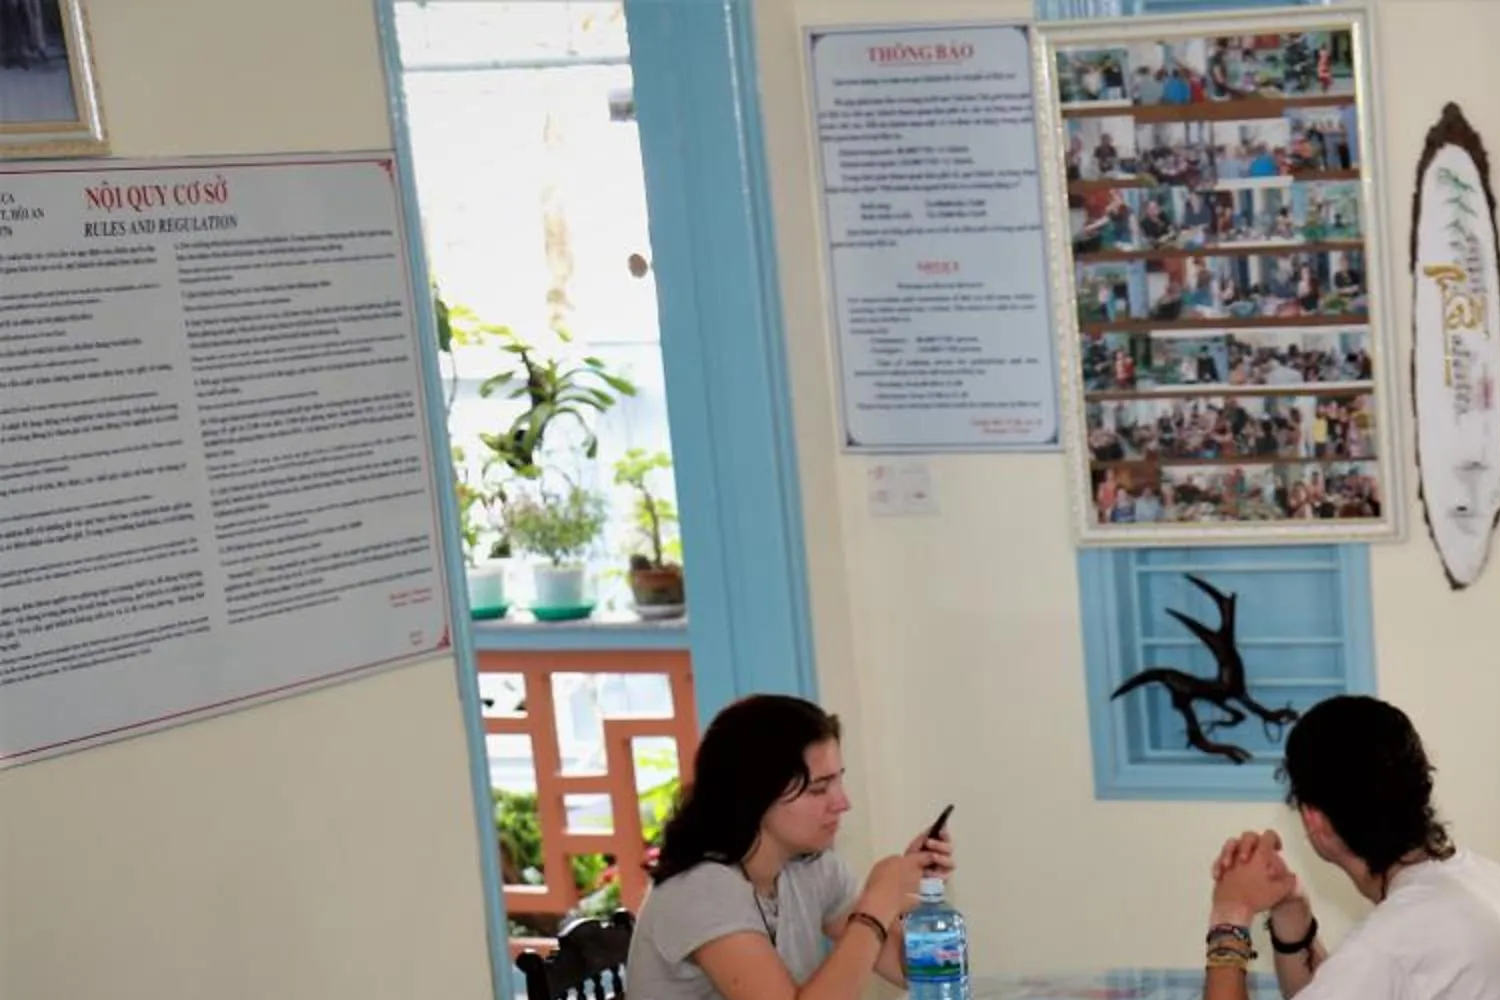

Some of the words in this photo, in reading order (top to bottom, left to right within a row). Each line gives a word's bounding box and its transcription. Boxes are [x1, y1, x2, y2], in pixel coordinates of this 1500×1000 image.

[86, 180, 122, 212] NỘI
[127, 184, 168, 212] QUY
[173, 180, 200, 206] CƠ
[84, 219, 126, 237] RULES
[130, 219, 156, 235] AND
[158, 214, 238, 234] REGULATION
